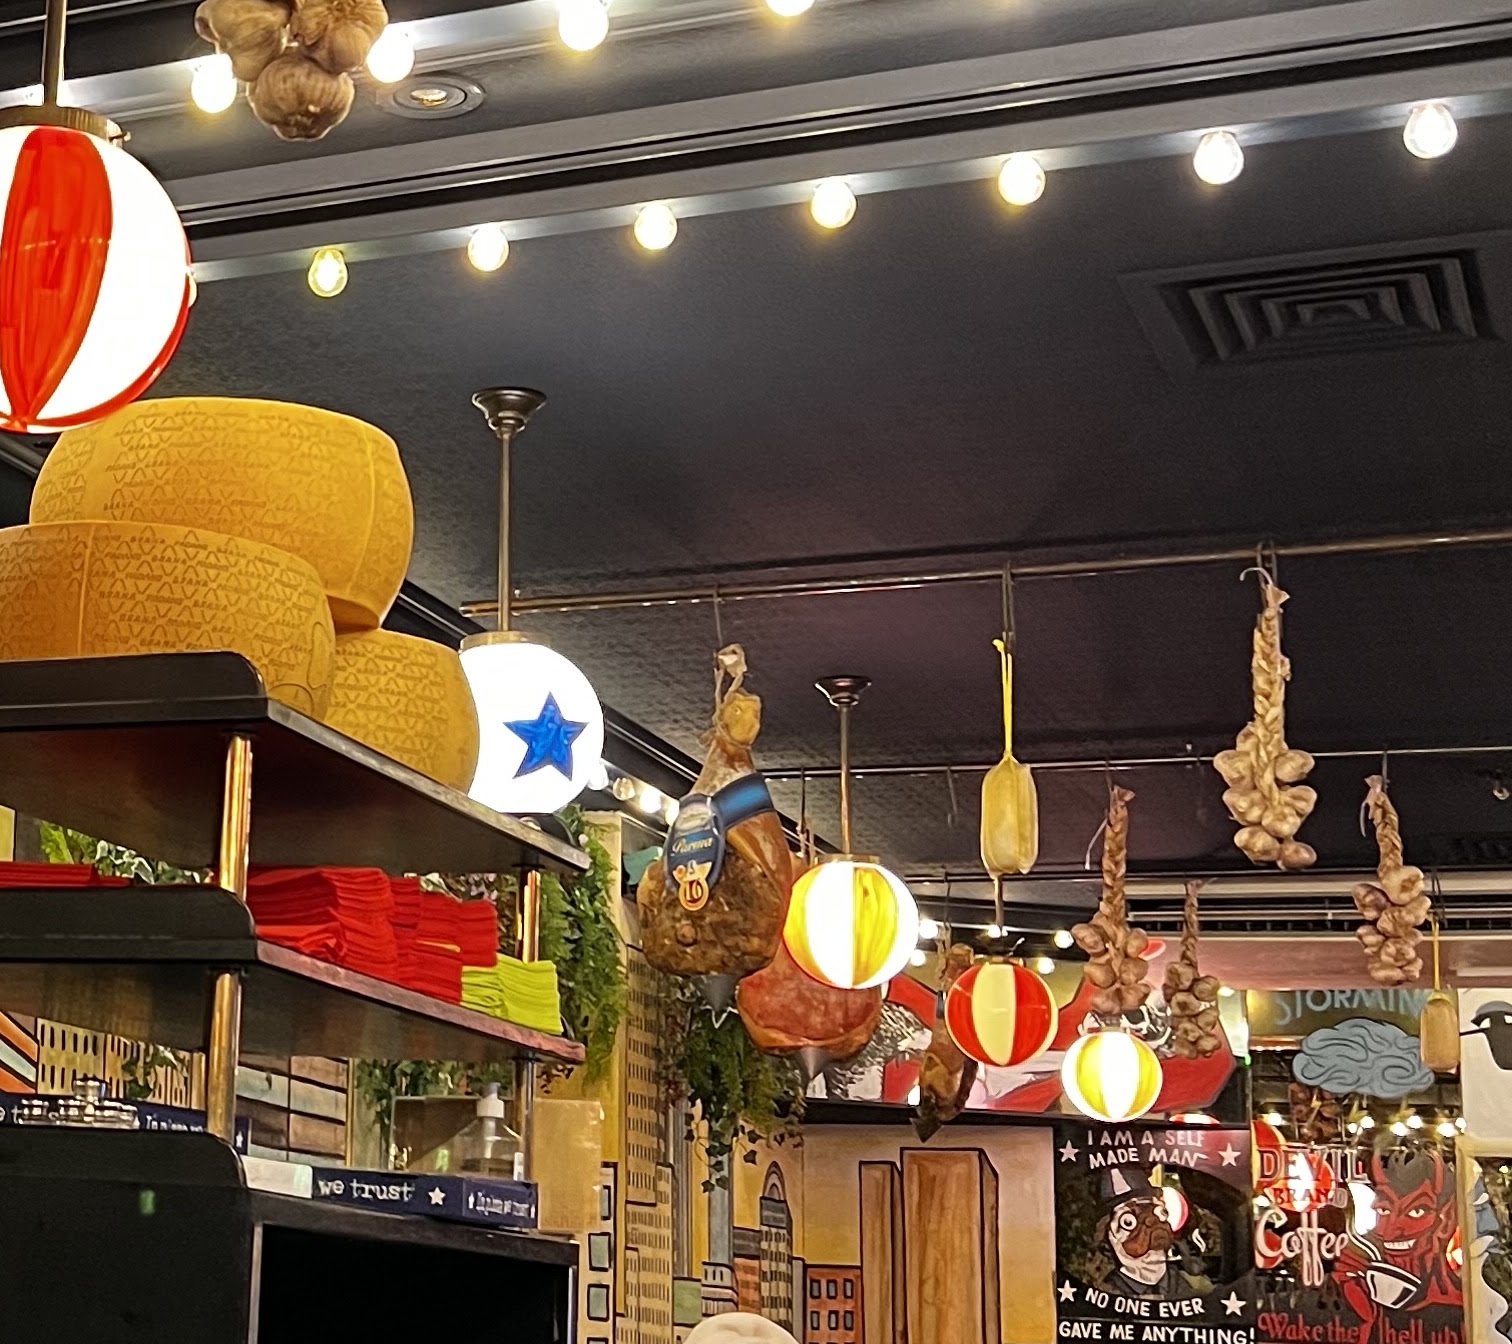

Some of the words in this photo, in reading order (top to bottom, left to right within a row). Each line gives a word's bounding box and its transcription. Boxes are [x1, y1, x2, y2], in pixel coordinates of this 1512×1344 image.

[1088, 1130, 1093, 1146] I
[1100, 1130, 1134, 1146] AM
[1141, 1130, 1154, 1146] A
[1165, 1130, 1205, 1147] SELF
[1088, 1148, 1139, 1170] MADE
[1149, 1147, 1208, 1168] MAN
[1257, 1147, 1372, 1184] DEVIL
[317, 1179, 345, 1196] we
[350, 1178, 415, 1202] trust
[1255, 1209, 1349, 1287] Coffee
[1085, 1287, 1109, 1309] NO
[1114, 1296, 1150, 1317] ONE
[1159, 1298, 1205, 1318] EVER
[1059, 1321, 1102, 1339] GAVE
[1109, 1323, 1134, 1340] ME
[1257, 1311, 1322, 1342] Wake
[1327, 1314, 1359, 1343] the
